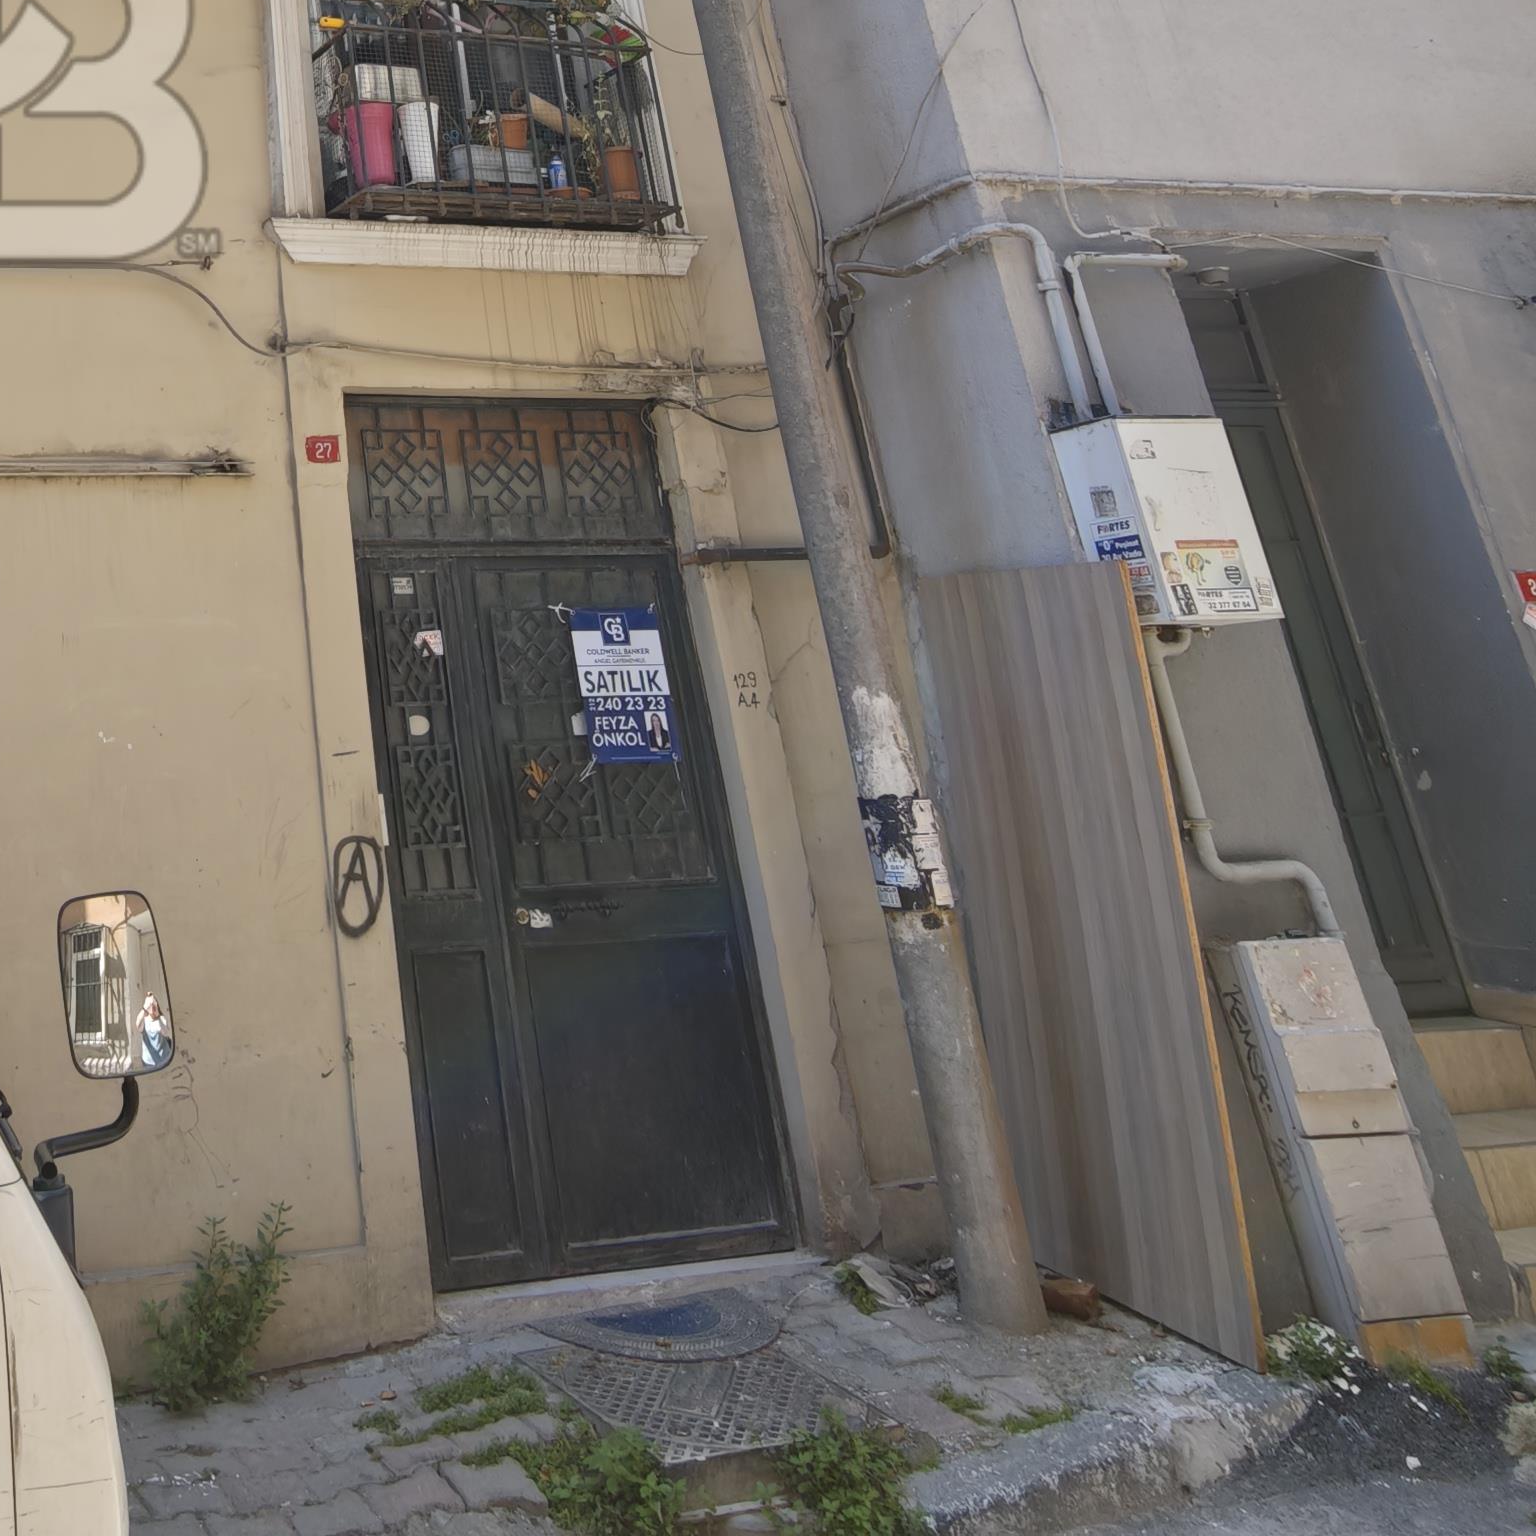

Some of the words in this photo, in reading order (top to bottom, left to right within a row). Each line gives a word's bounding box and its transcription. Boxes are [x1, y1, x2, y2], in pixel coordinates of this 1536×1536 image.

[315, 442, 332, 459] 27
[586, 648, 623, 656] COLDWELL
[623, 647, 650, 655] BANKER
[583, 669, 663, 693] SATILIK
[734, 671, 757, 689] 129
[596, 697, 622, 712] 240
[625, 696, 644, 711] 23
[647, 696, 666, 711] 23
[594, 715, 639, 730] FEYZA
[592, 729, 647, 748] ÖNKOL
